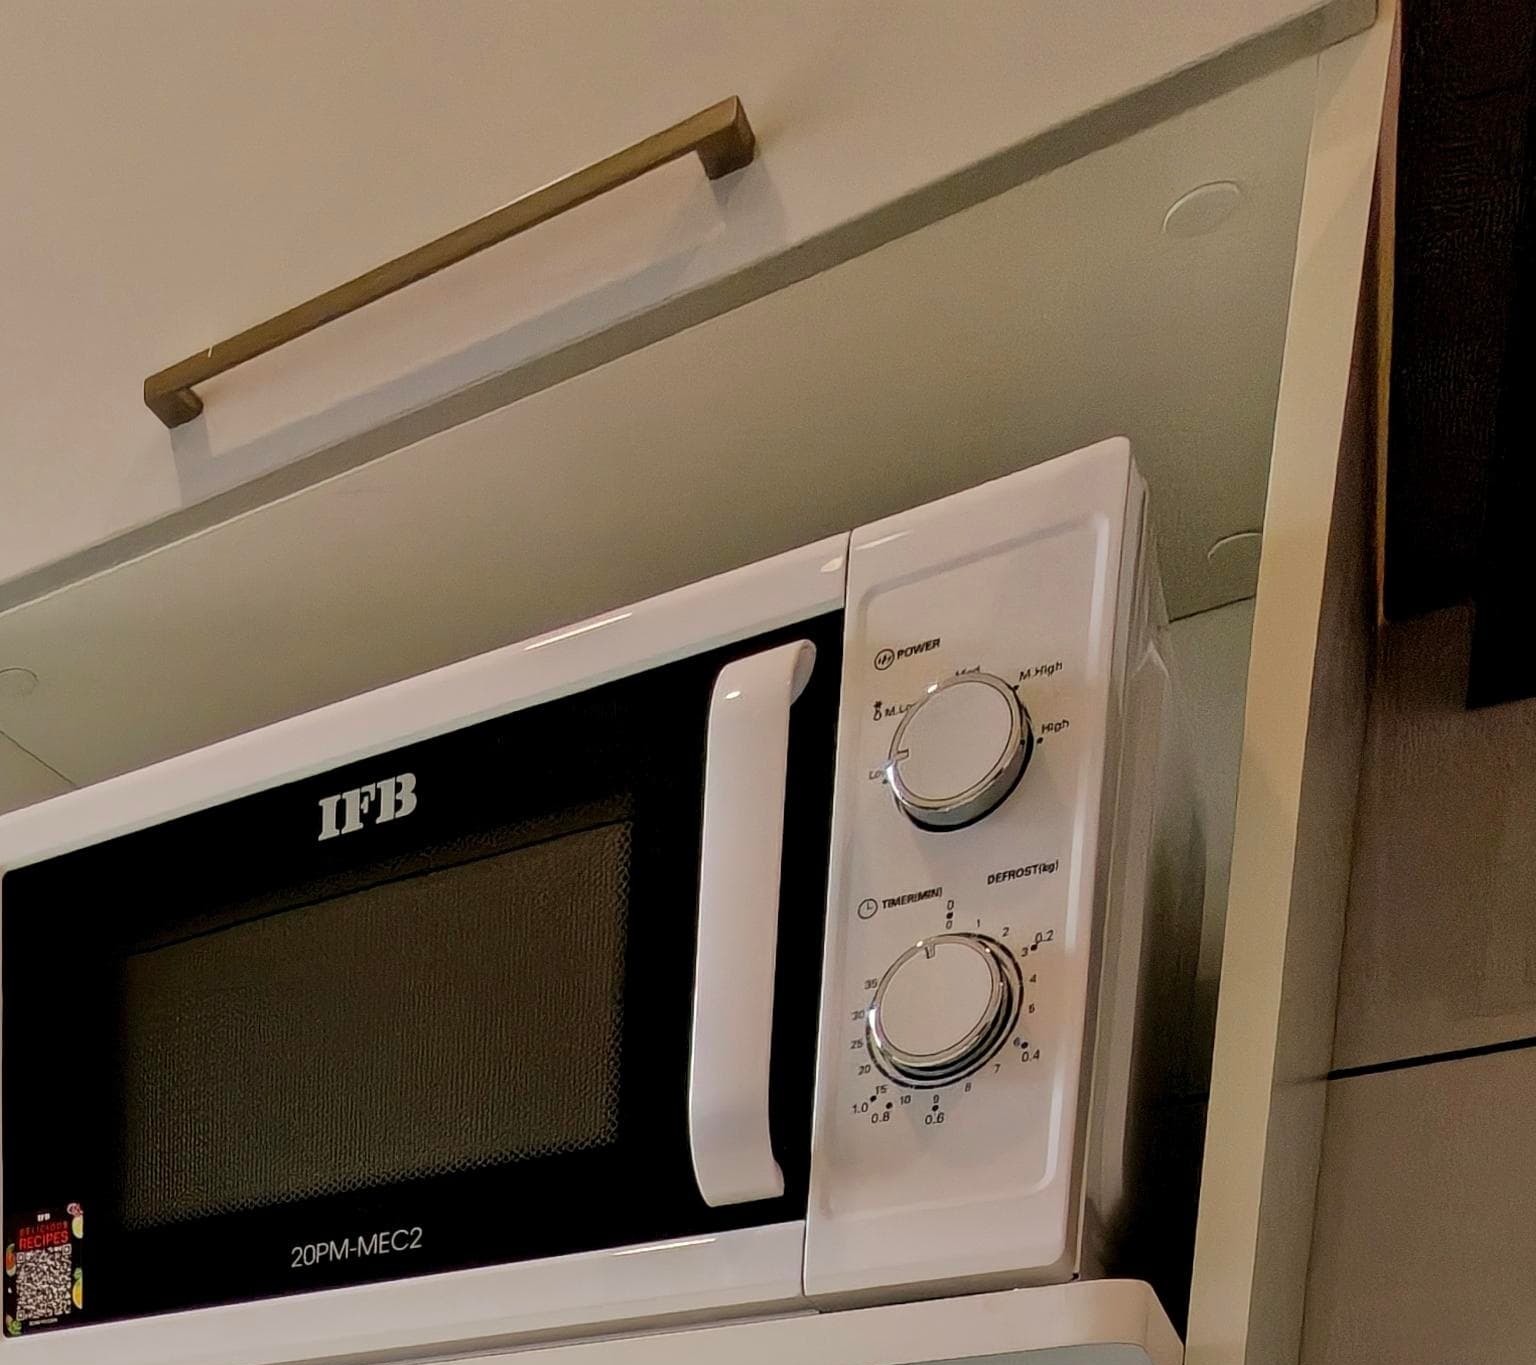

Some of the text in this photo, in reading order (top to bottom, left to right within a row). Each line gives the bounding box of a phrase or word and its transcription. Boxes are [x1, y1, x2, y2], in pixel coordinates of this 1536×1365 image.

[896, 638, 941, 660] POWER
[1041, 719, 1070, 734] High
[318, 773, 417, 841] IFB
[1002, 927, 1010, 937] 2
[1035, 930, 1055, 944] 0.2
[1021, 947, 1029, 957] 3
[864, 978, 878, 990] 35
[1029, 974, 1037, 983] 4
[851, 1039, 863, 1049] 25
[1021, 1050, 1040, 1062] 0.4
[858, 1064, 871, 1076] 20
[993, 1063, 1001, 1073] 7
[900, 1095, 911, 1105] 10
[852, 1102, 868, 1114] 1.0
[871, 1111, 891, 1124] 0.8
[925, 1112, 944, 1125] 0.6
[19, 1230, 69, 1250] RECIPES
[291, 1227, 423, 1268] 20PM-MEC2
